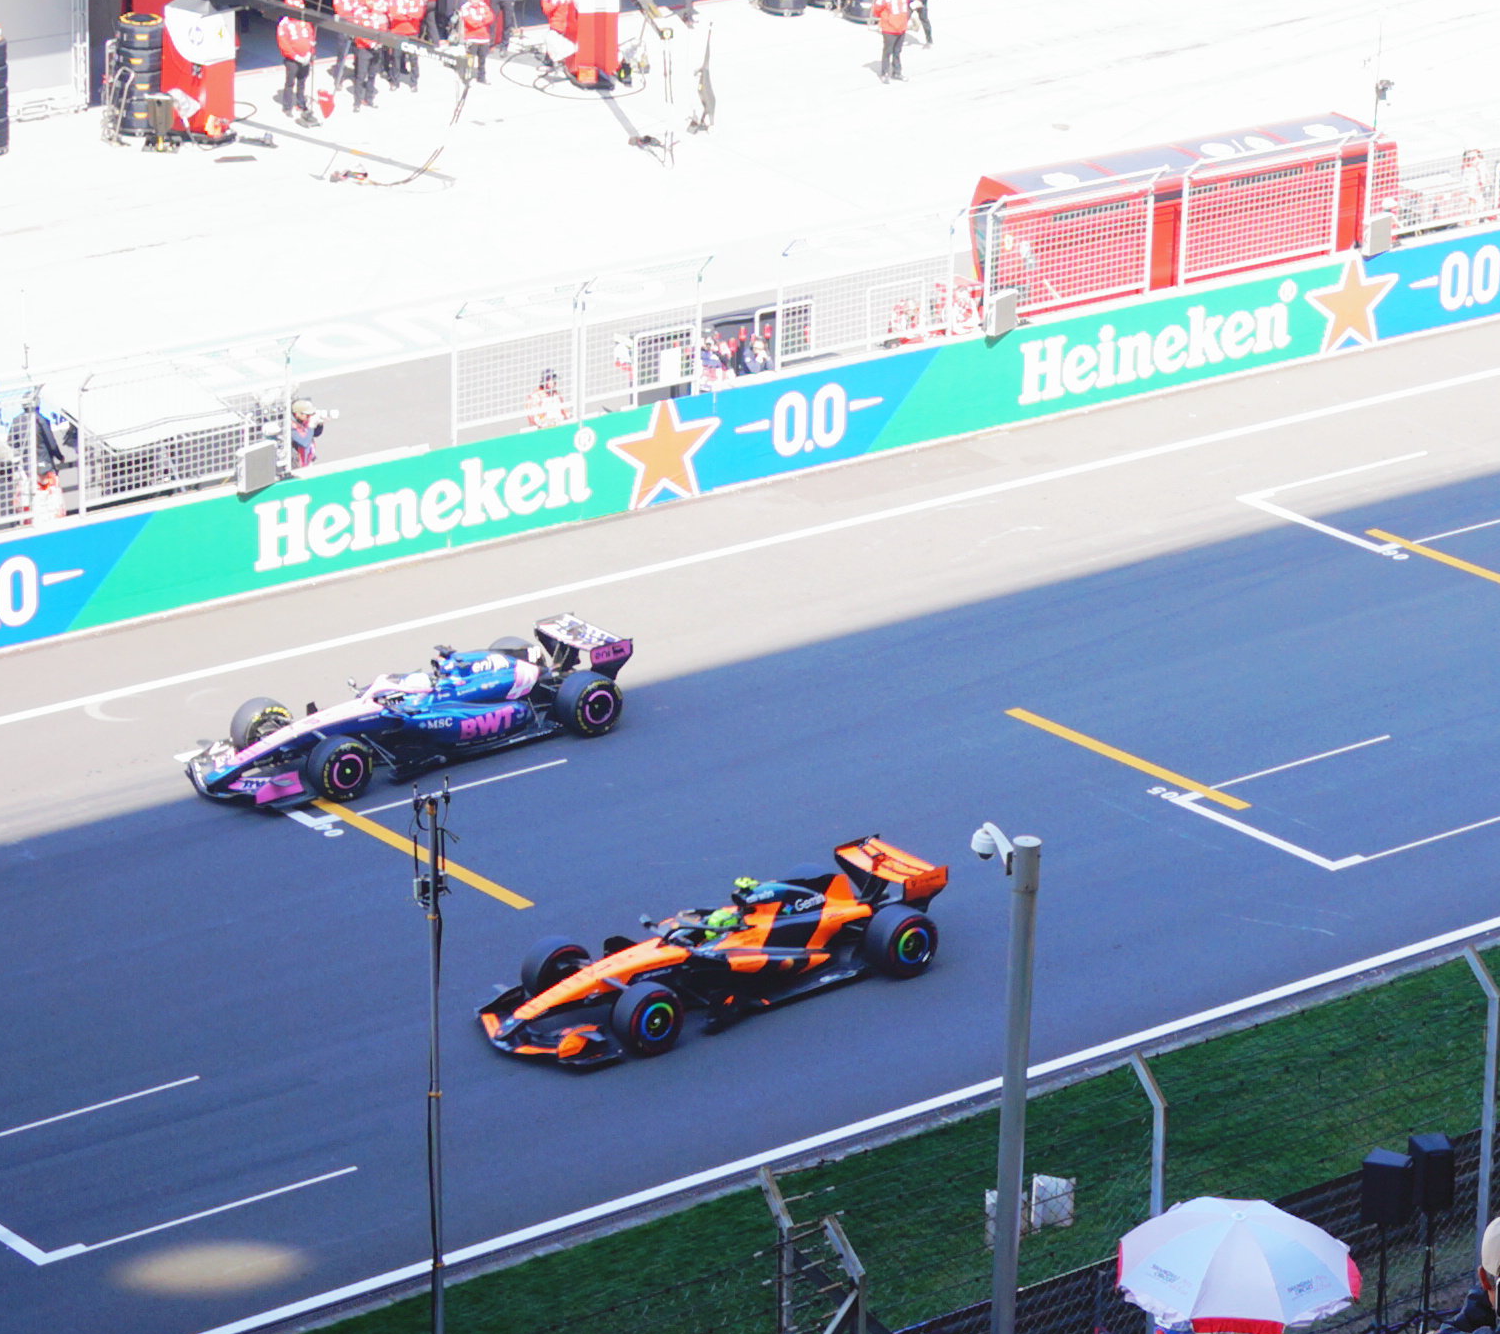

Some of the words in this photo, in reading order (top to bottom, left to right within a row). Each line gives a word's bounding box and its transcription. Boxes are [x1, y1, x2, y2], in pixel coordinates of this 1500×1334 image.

[1018, 297, 1290, 406] Heineken
[254, 448, 591, 573] Heineken
[595, 649, 611, 660] eni
[472, 657, 494, 674] eni
[427, 716, 454, 730] MSC
[460, 706, 517, 741] BWT
[794, 893, 826, 913] Gemini
